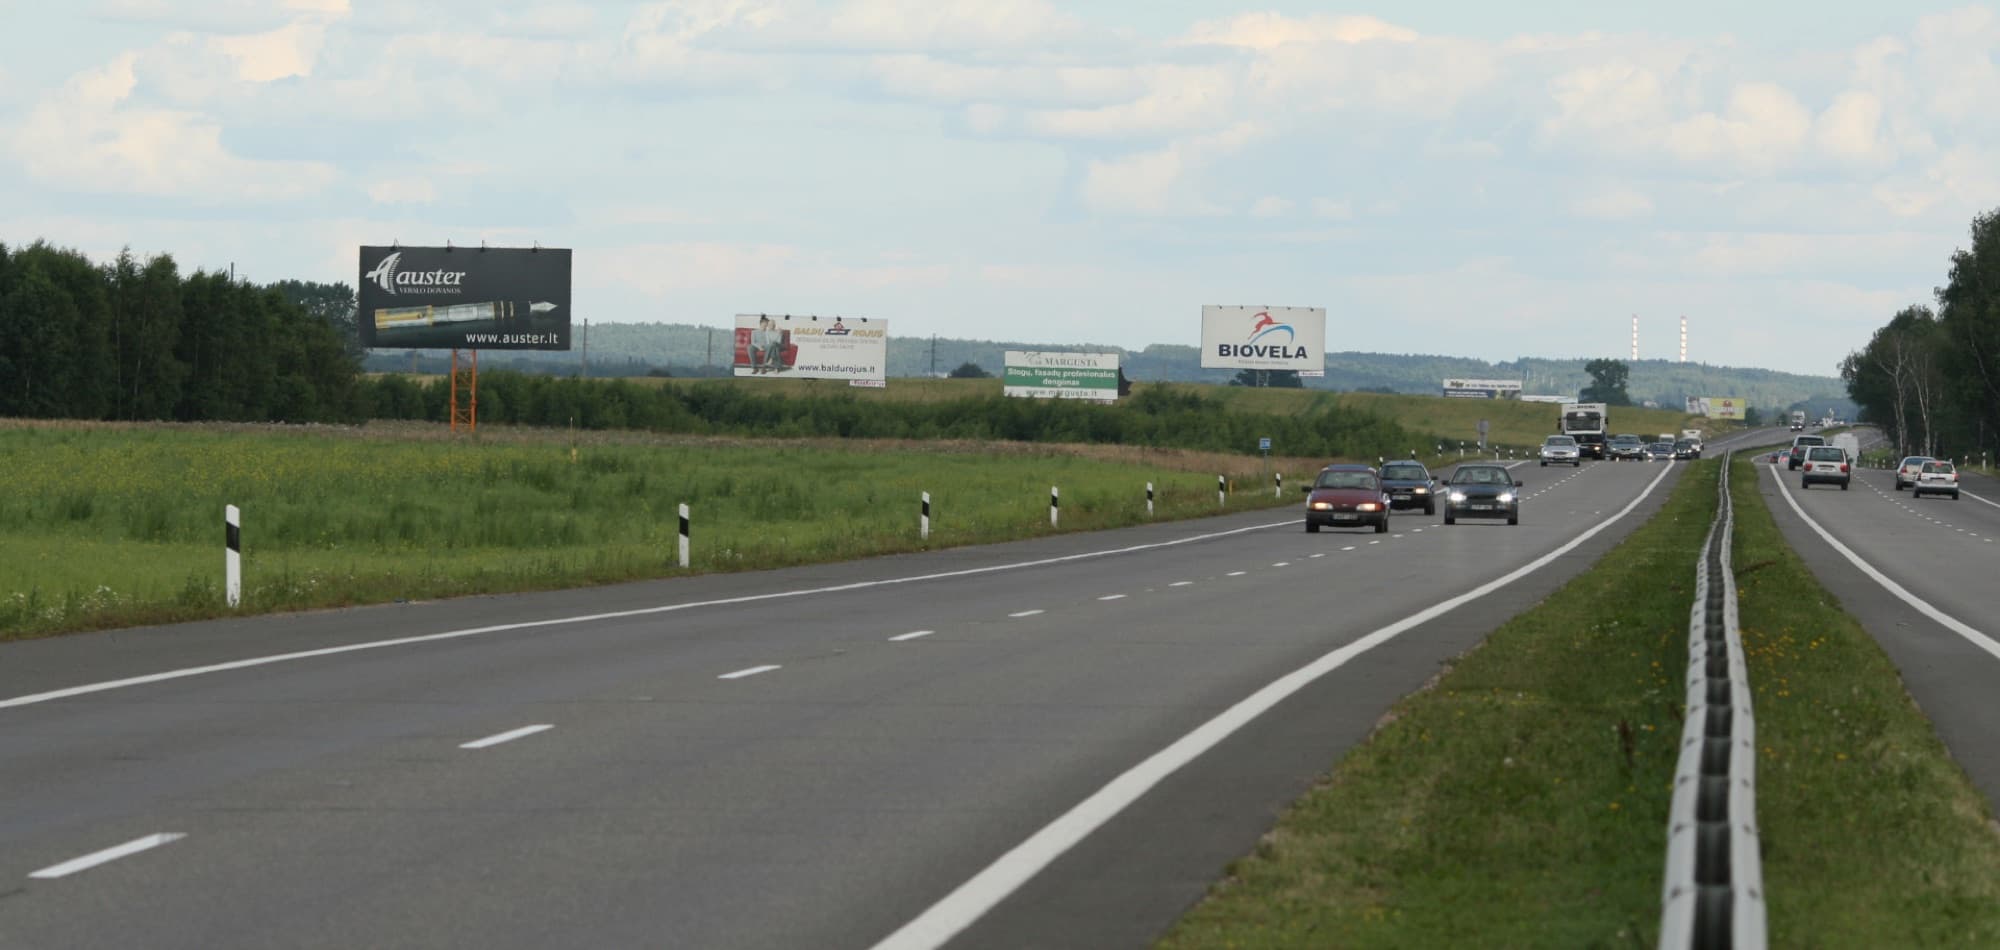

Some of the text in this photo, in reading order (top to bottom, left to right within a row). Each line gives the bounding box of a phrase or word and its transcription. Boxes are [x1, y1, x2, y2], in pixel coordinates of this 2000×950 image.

[396, 268, 466, 285] auster
[465, 332, 559, 344] www.auster.lt
[1218, 344, 1308, 359] BIOVELA
[798, 363, 875, 374] www.baldurojus.lt
[1045, 358, 1098, 367] MARGUSTA
